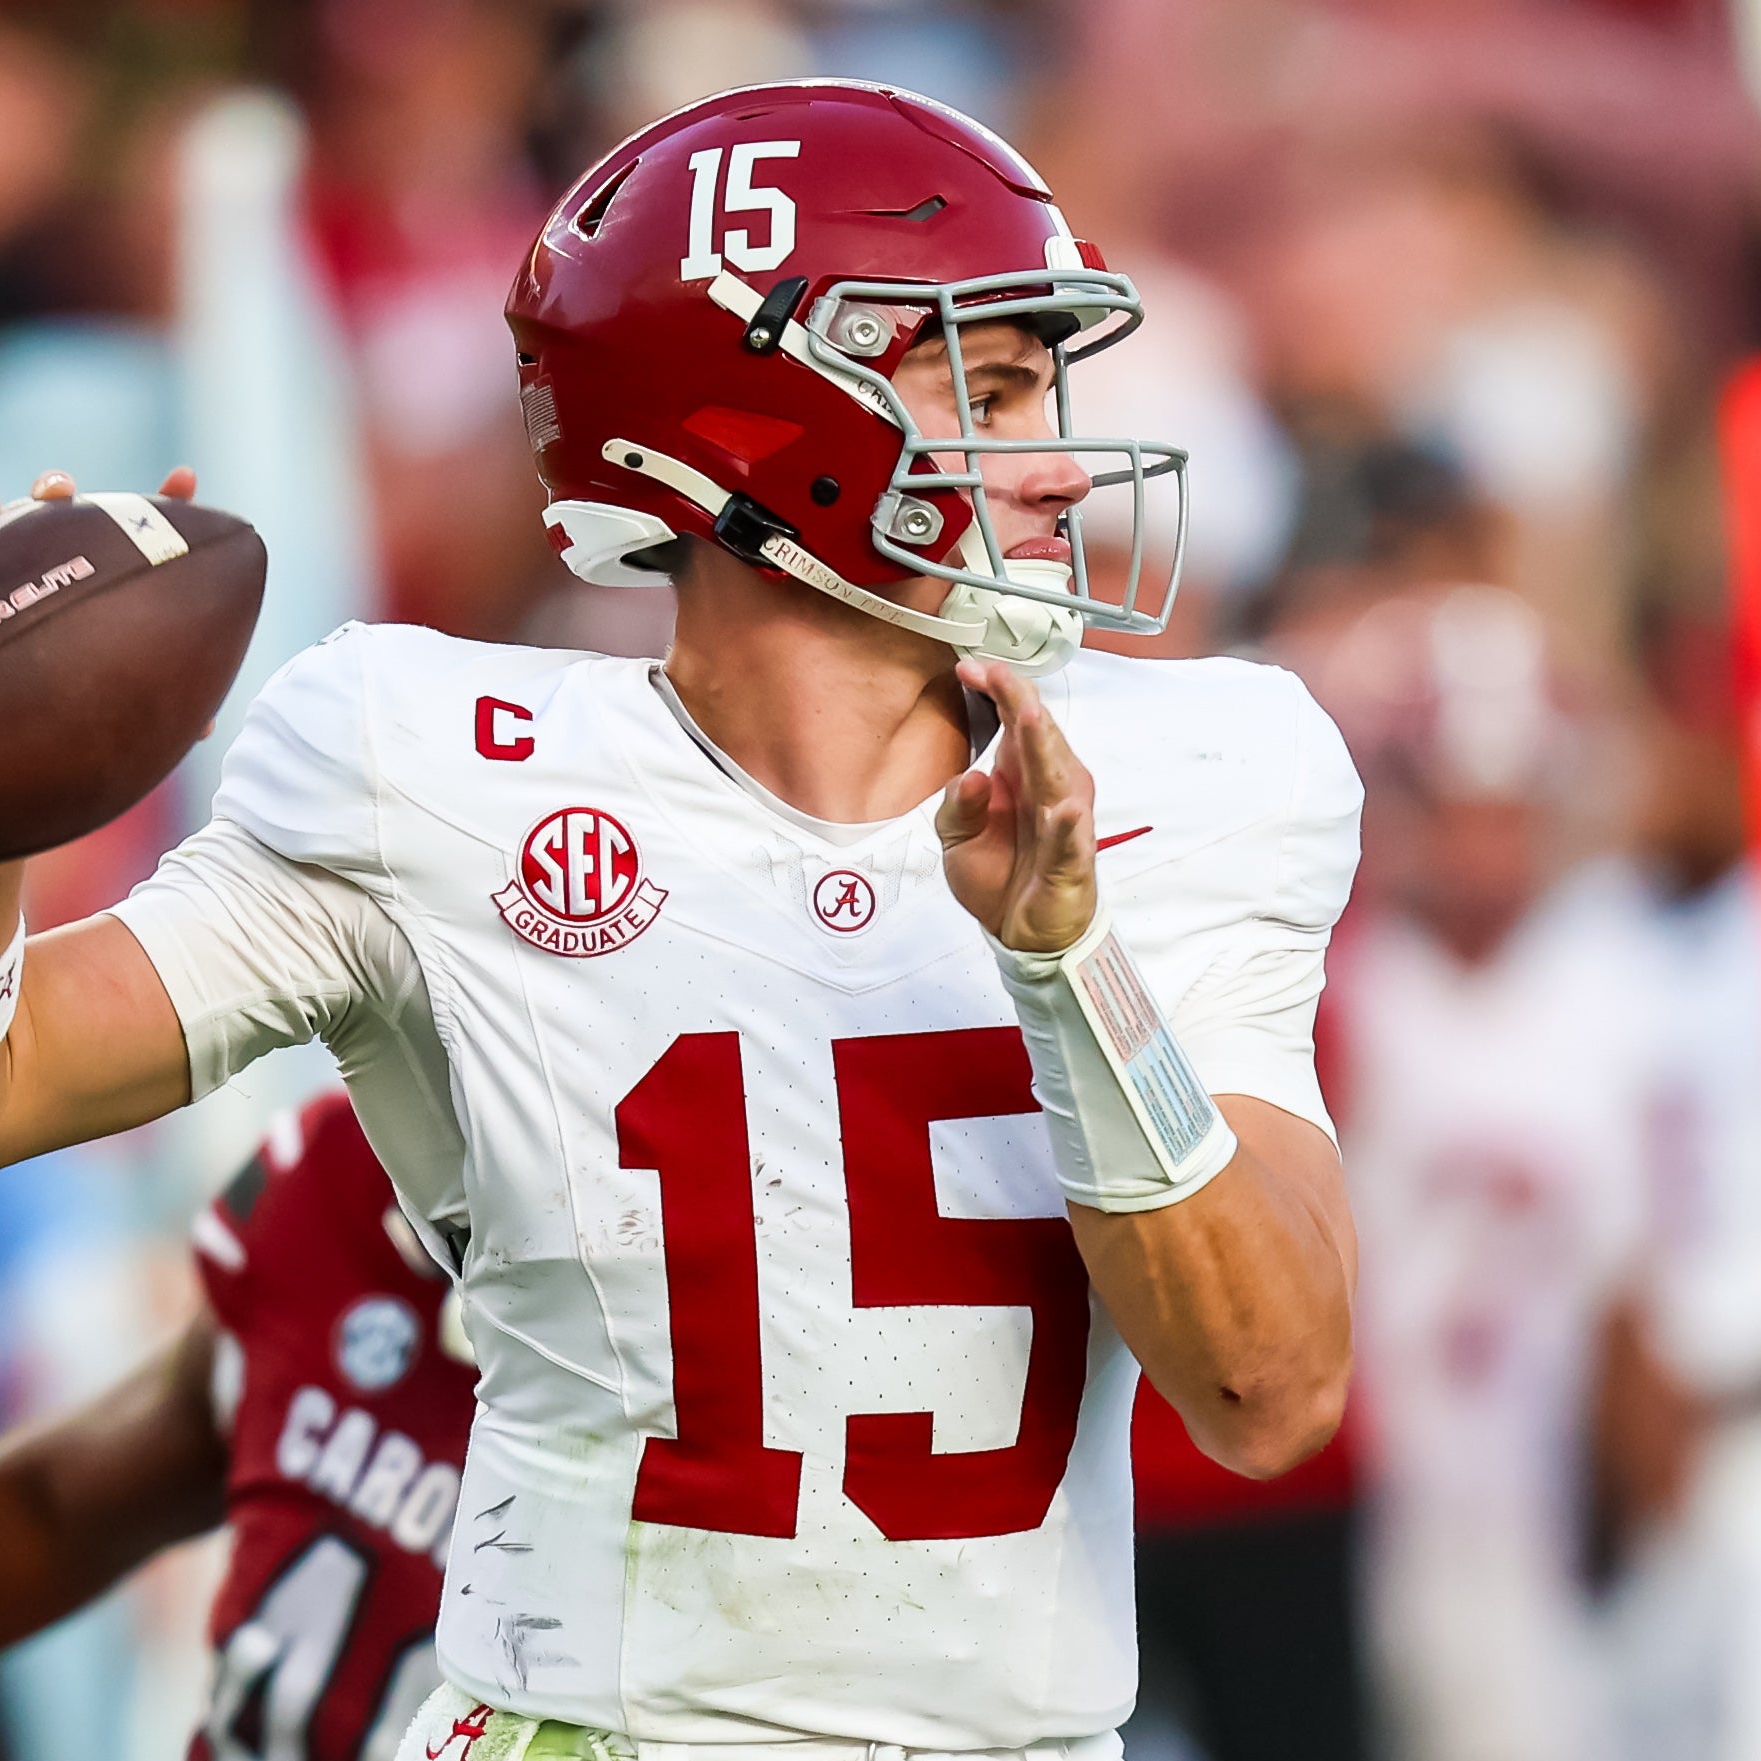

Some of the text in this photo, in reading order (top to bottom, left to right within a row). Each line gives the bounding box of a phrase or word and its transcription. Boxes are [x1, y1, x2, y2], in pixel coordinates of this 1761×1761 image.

[680, 140, 801, 281] 15
[475, 695, 535, 761] C
[528, 812, 631, 916] SEC
[514, 908, 646, 952] GRADUATE
[615, 1025, 1091, 1542] 15
[275, 1384, 461, 1569] CARO
